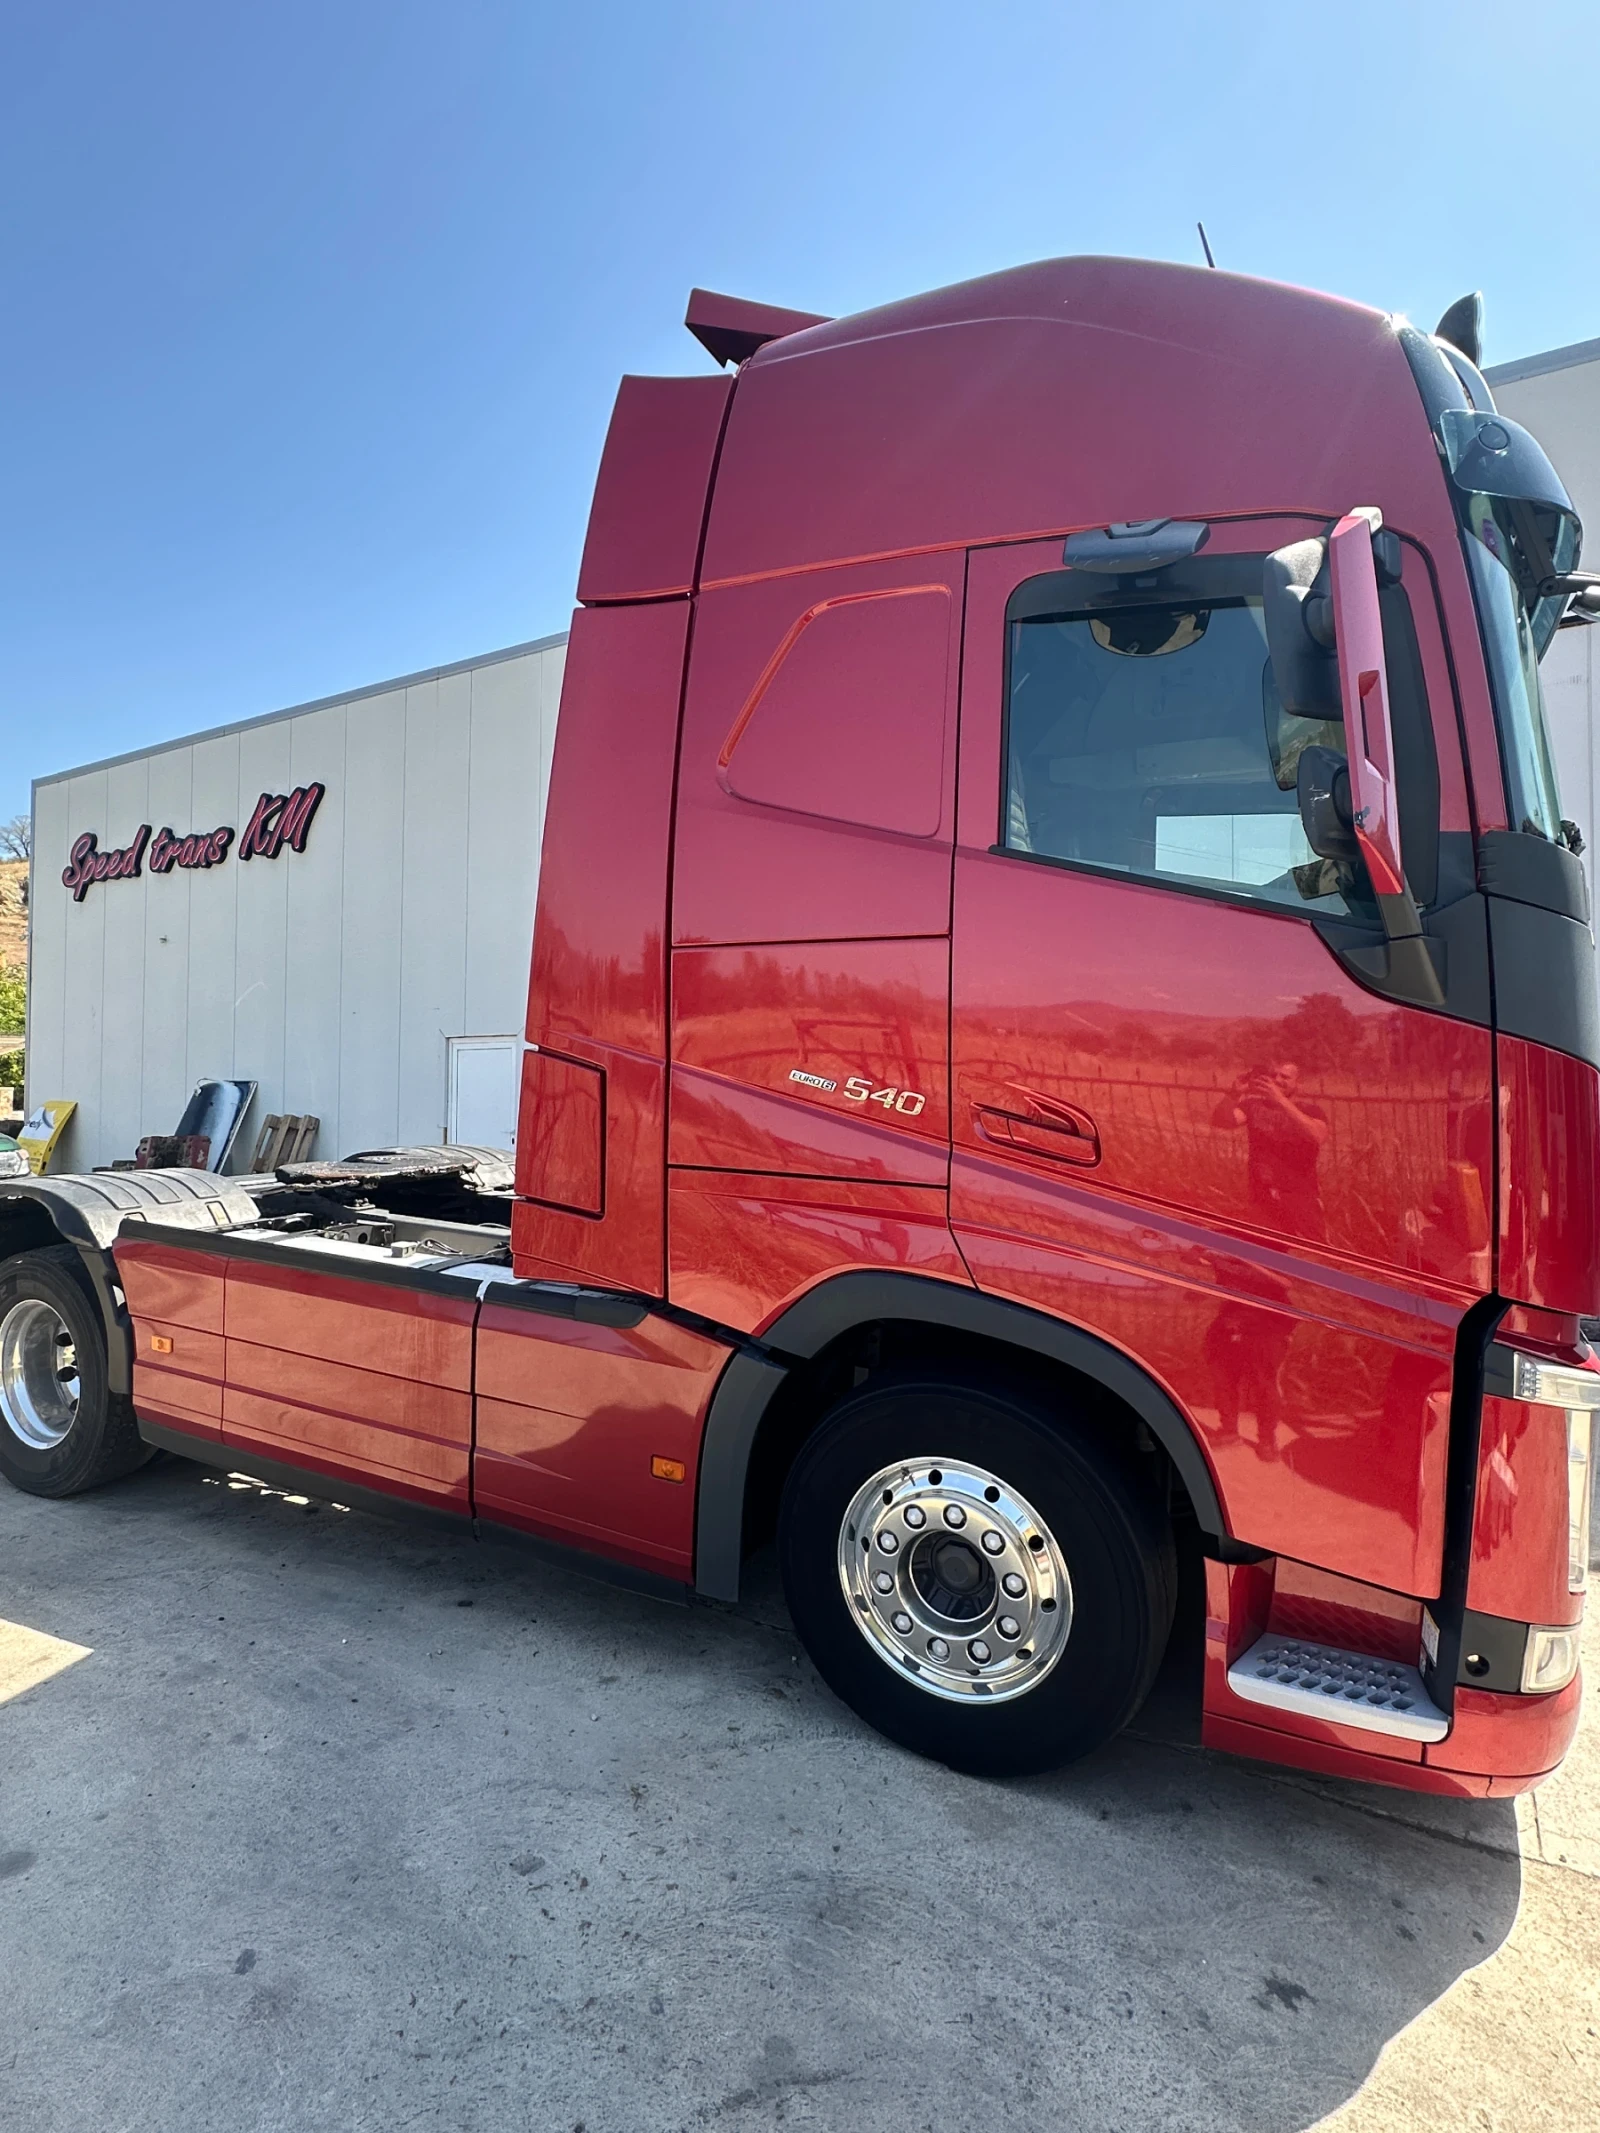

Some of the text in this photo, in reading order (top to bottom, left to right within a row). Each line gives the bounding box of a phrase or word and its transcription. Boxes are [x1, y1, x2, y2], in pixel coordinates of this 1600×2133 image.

[62, 782, 325, 902] Speed trans KM
[791, 1071, 821, 1087] EURO
[843, 1077, 926, 1116] 540
